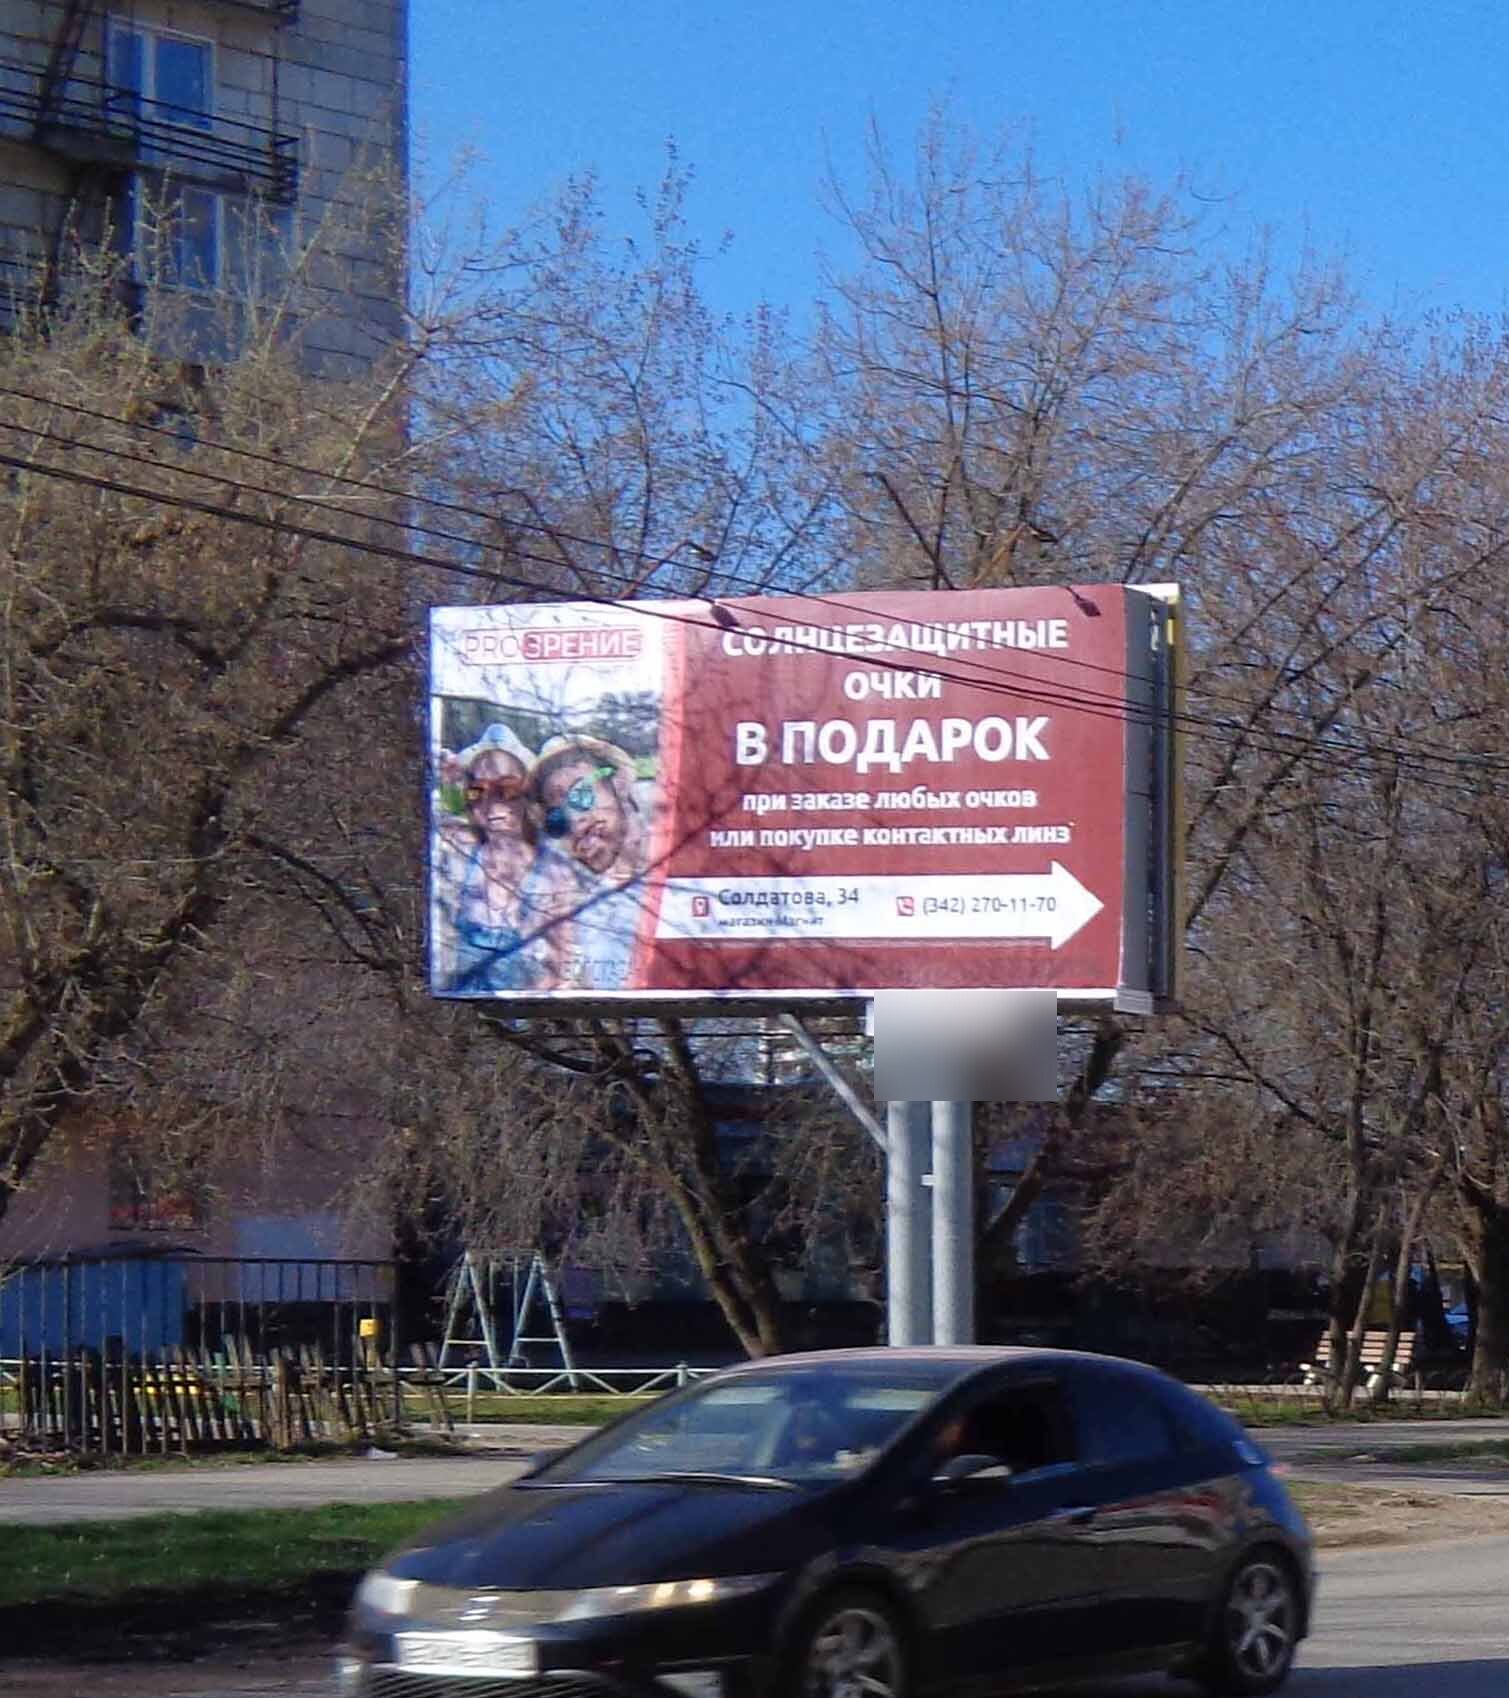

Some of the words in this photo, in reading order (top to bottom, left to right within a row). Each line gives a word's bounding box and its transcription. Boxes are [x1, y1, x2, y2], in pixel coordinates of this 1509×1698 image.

[722, 619, 1069, 657] СОЛНЦЕЗАЩИТНЫЕ
[843, 671, 942, 700] ОЧКИ
[735, 722, 768, 765] В
[782, 716, 1050, 773] ПОДАРОК
[742, 792, 787, 816] при
[791, 791, 869, 811] заказе
[873, 786, 960, 810] любых
[965, 789, 1037, 808] очков
[709, 829, 755, 848] или
[759, 828, 859, 850] покупке
[863, 825, 1007, 847] контактных
[837, 887, 860, 906] 34
[922, 896, 966, 915] (342)
[971, 896, 1057, 914] 270-11-70
